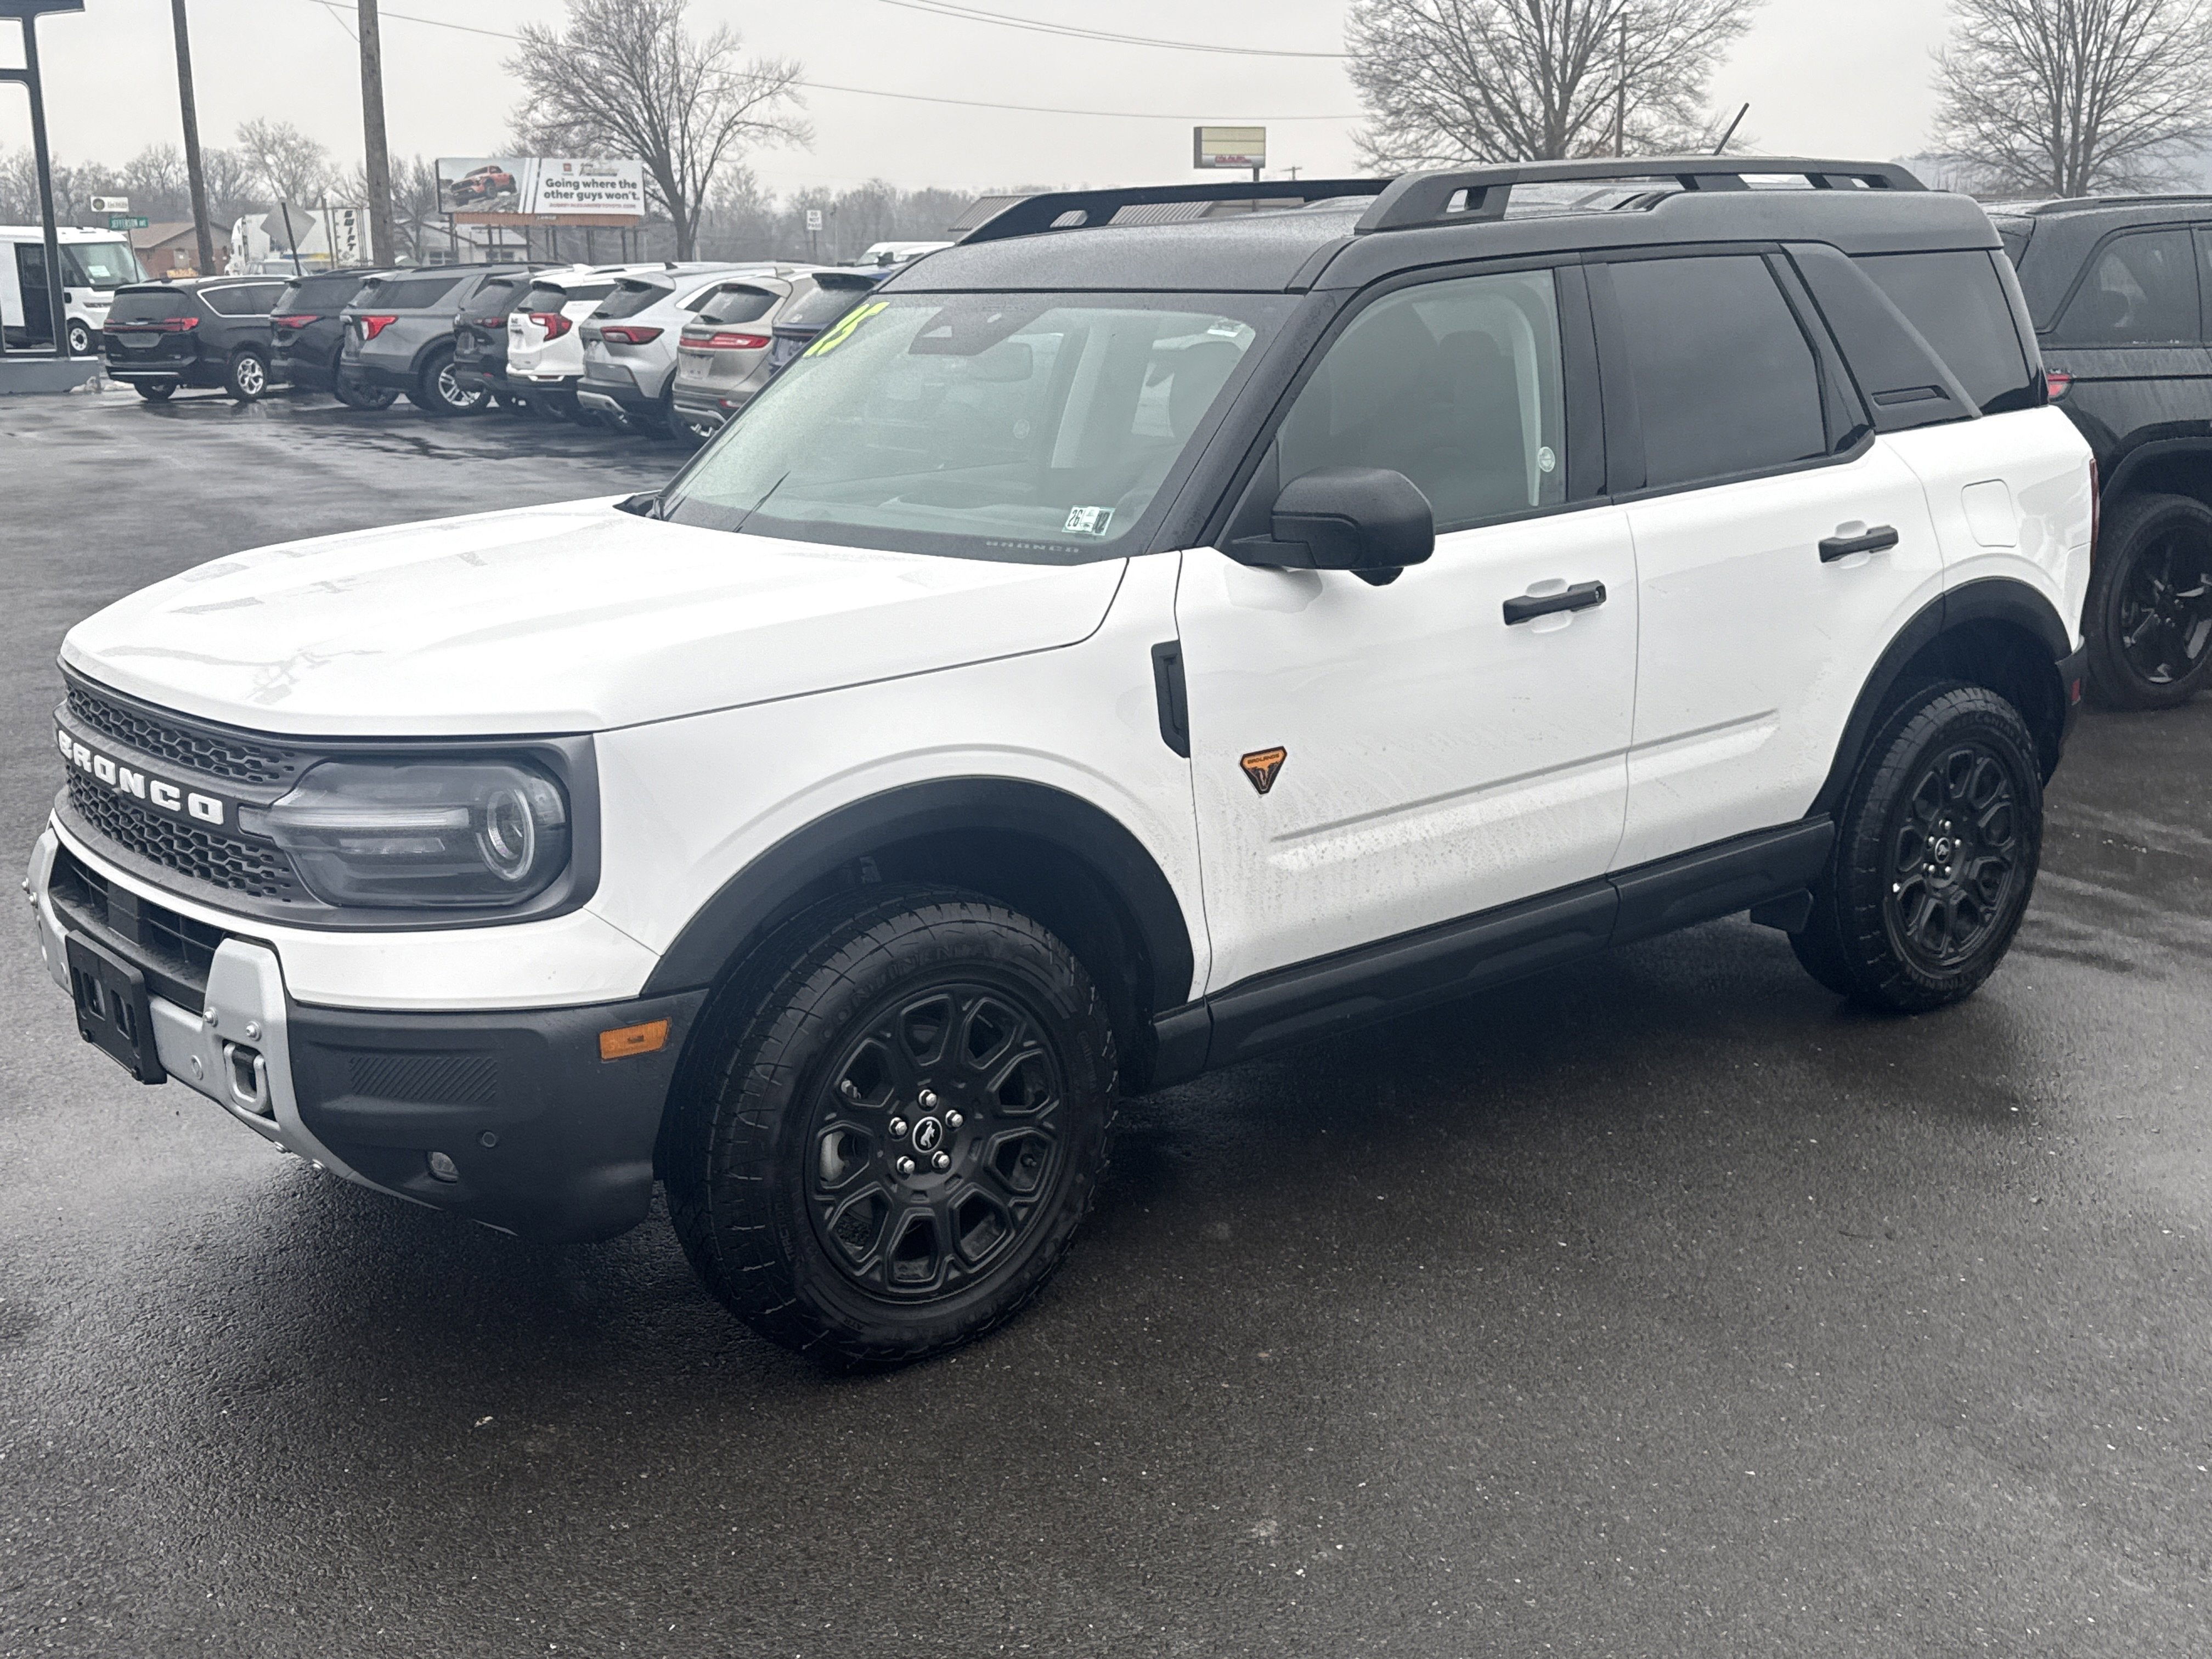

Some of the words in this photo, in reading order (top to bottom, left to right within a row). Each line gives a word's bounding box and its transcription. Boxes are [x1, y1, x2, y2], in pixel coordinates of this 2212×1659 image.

[545, 178, 580, 190] Going
[582, 179, 617, 188] where
[619, 179, 637, 189] the
[544, 190, 574, 199] other
[577, 191, 603, 201] guys
[605, 191, 640, 200] won't.
[111, 219, 138, 229] JEFFERSON
[344, 210, 357, 251] SWIFT
[1068, 509, 1084, 527] 26
[58, 730, 224, 825] BRONCO
